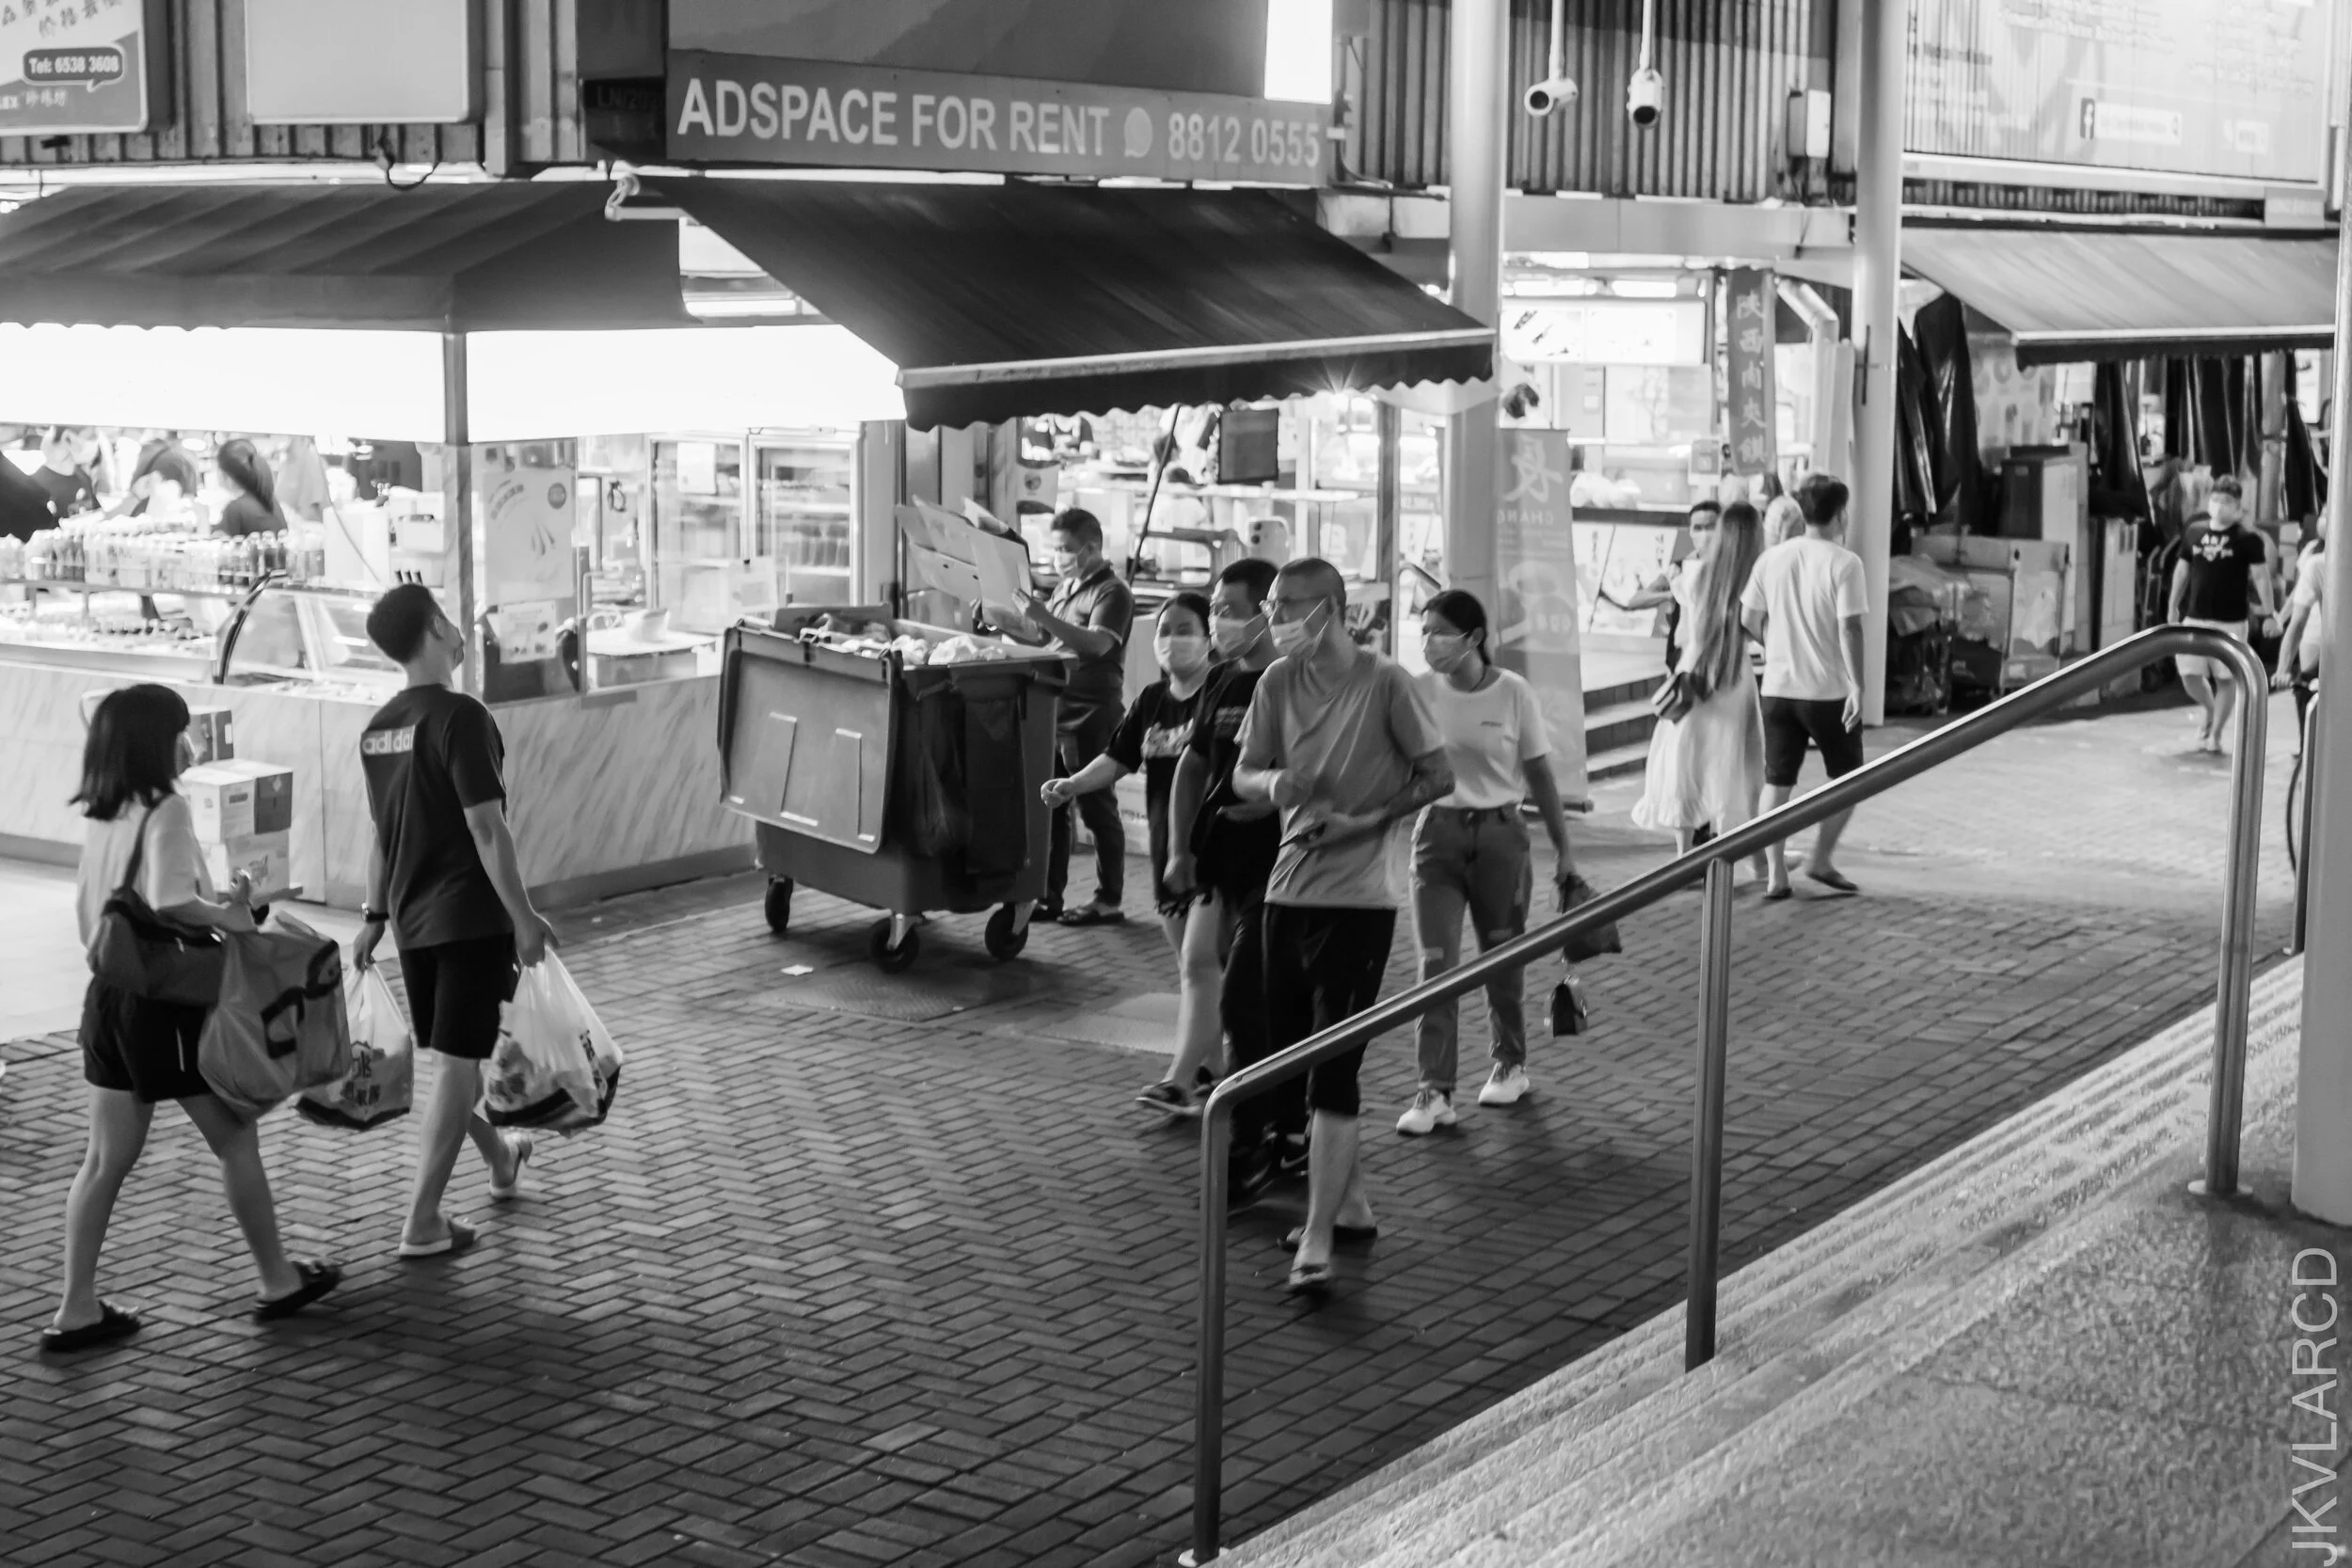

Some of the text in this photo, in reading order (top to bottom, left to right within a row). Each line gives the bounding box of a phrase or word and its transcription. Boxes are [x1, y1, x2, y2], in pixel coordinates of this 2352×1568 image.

[28, 56, 52, 74] Tel:
[676, 78, 1321, 167] ADSPACE FOR RENT 8812 0555
[361, 730, 415, 755] adida
